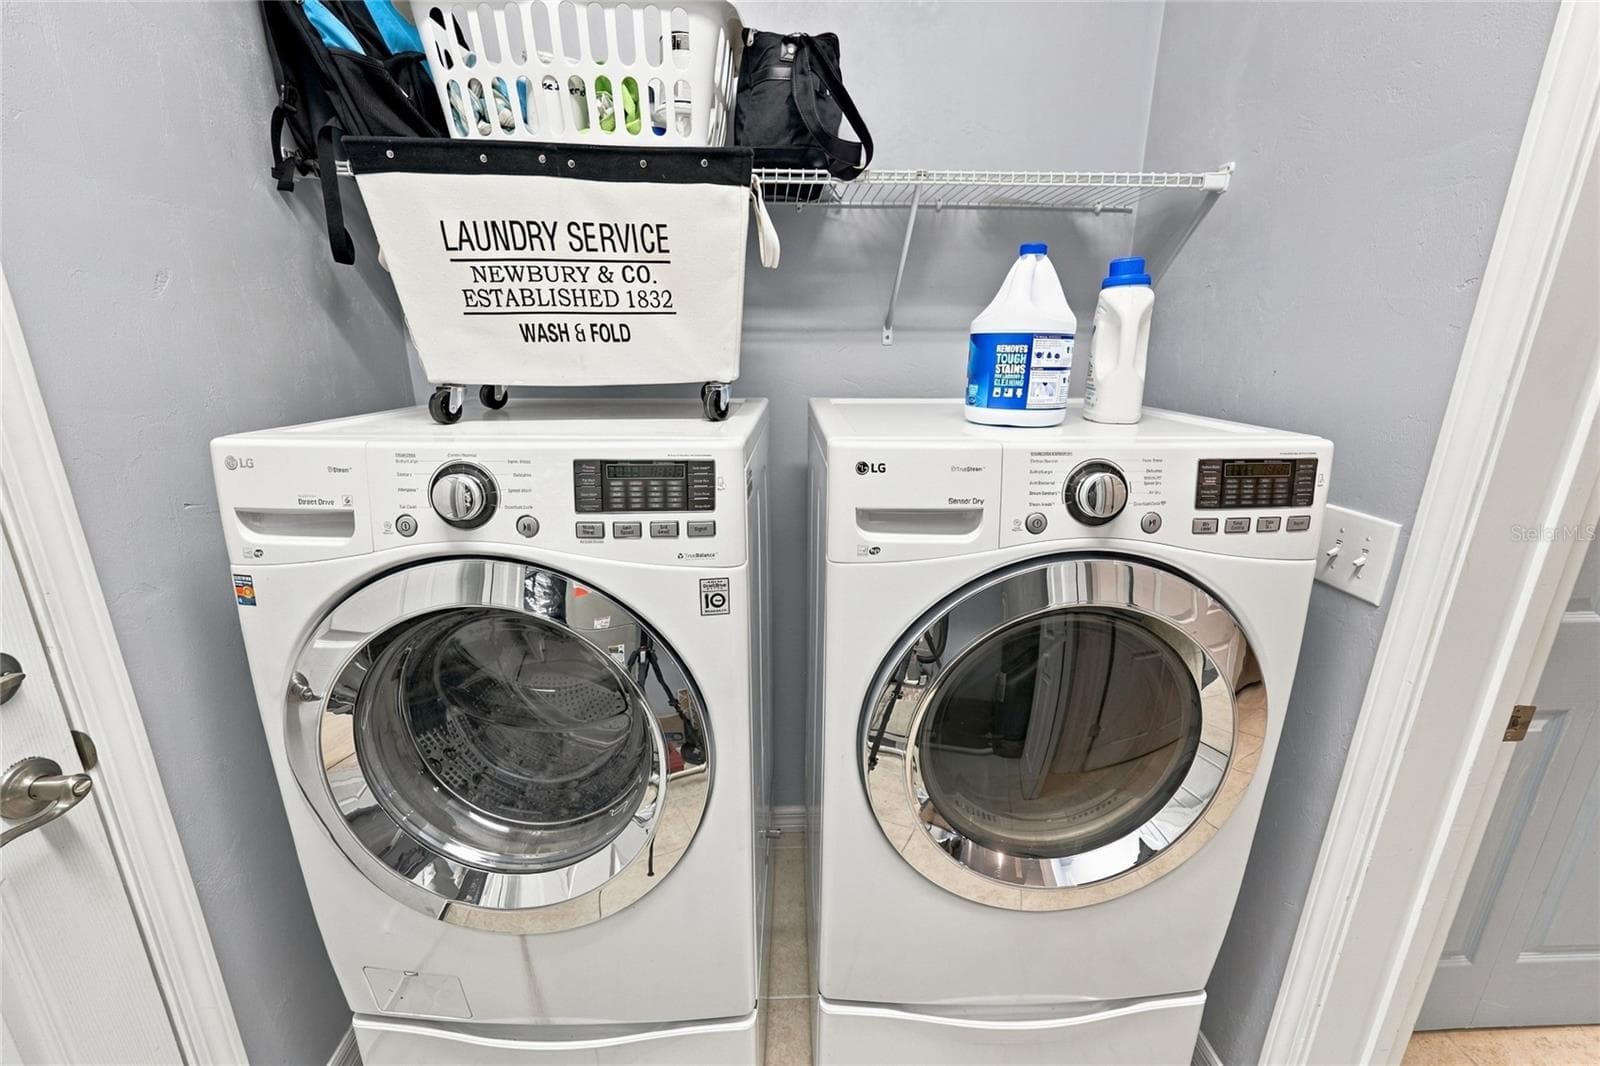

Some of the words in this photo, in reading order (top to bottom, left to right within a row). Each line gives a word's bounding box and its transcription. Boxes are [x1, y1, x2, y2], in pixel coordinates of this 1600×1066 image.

[440, 220, 558, 252] LAUNDRY
[567, 221, 671, 254] SERVICE
[470, 265, 590, 283] NEWBURY
[597, 265, 614, 284] &
[621, 265, 658, 284] CO.
[462, 288, 620, 308] ESTABLISHED
[626, 290, 673, 309] 1832
[519, 323, 570, 343] WASH
[575, 323, 586, 342] &
[590, 323, 631, 343] FOLD
[996, 344, 1028, 353] REMOVES
[996, 353, 1027, 363] TOUGH
[995, 364, 1025, 374] STAINS
[239, 458, 254, 469] LG
[871, 463, 886, 473] LG
[298, 498, 316, 506] Direct
[318, 498, 335, 506] Drive
[948, 497, 971, 505] Sensor
[972, 498, 984, 506] Dry
